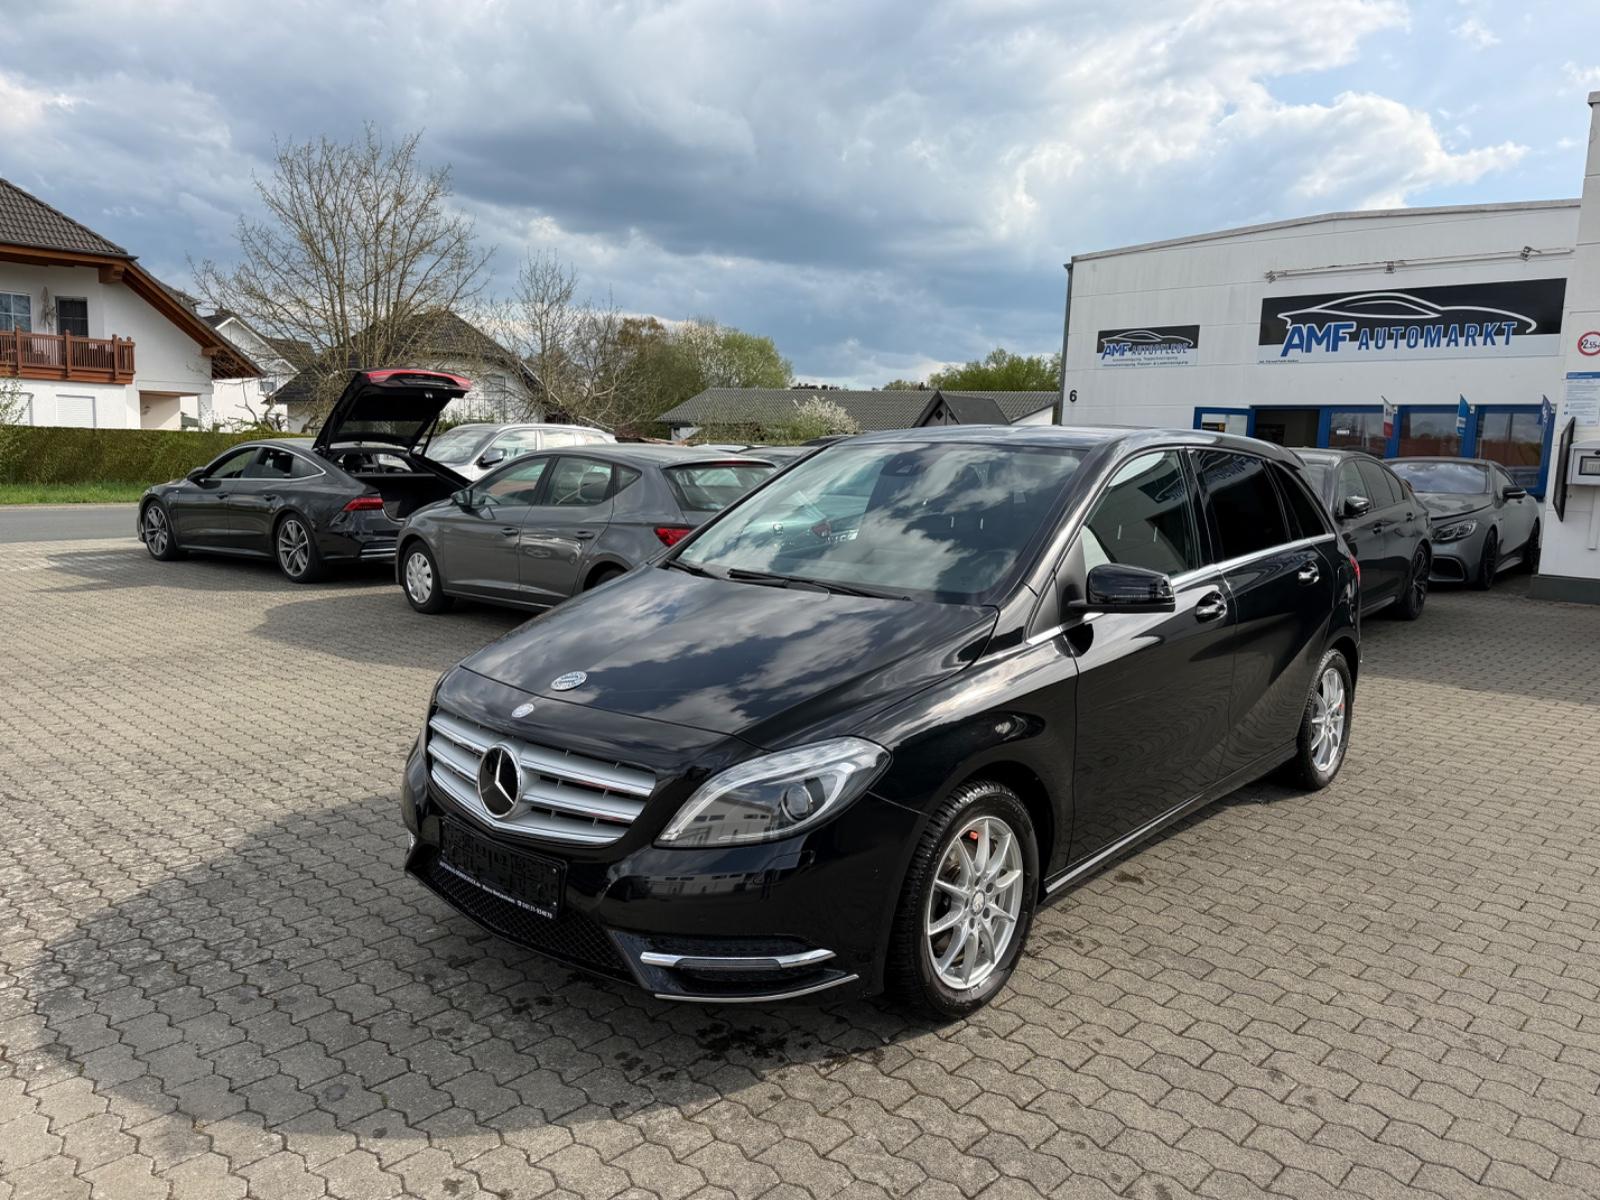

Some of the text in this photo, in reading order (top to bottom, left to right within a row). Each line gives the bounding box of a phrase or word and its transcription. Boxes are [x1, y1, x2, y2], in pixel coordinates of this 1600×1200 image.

[1280, 321, 1517, 357] AMF AUTOMARKT
[1101, 343, 1131, 360] AMF
[1069, 390, 1077, 403] 6
